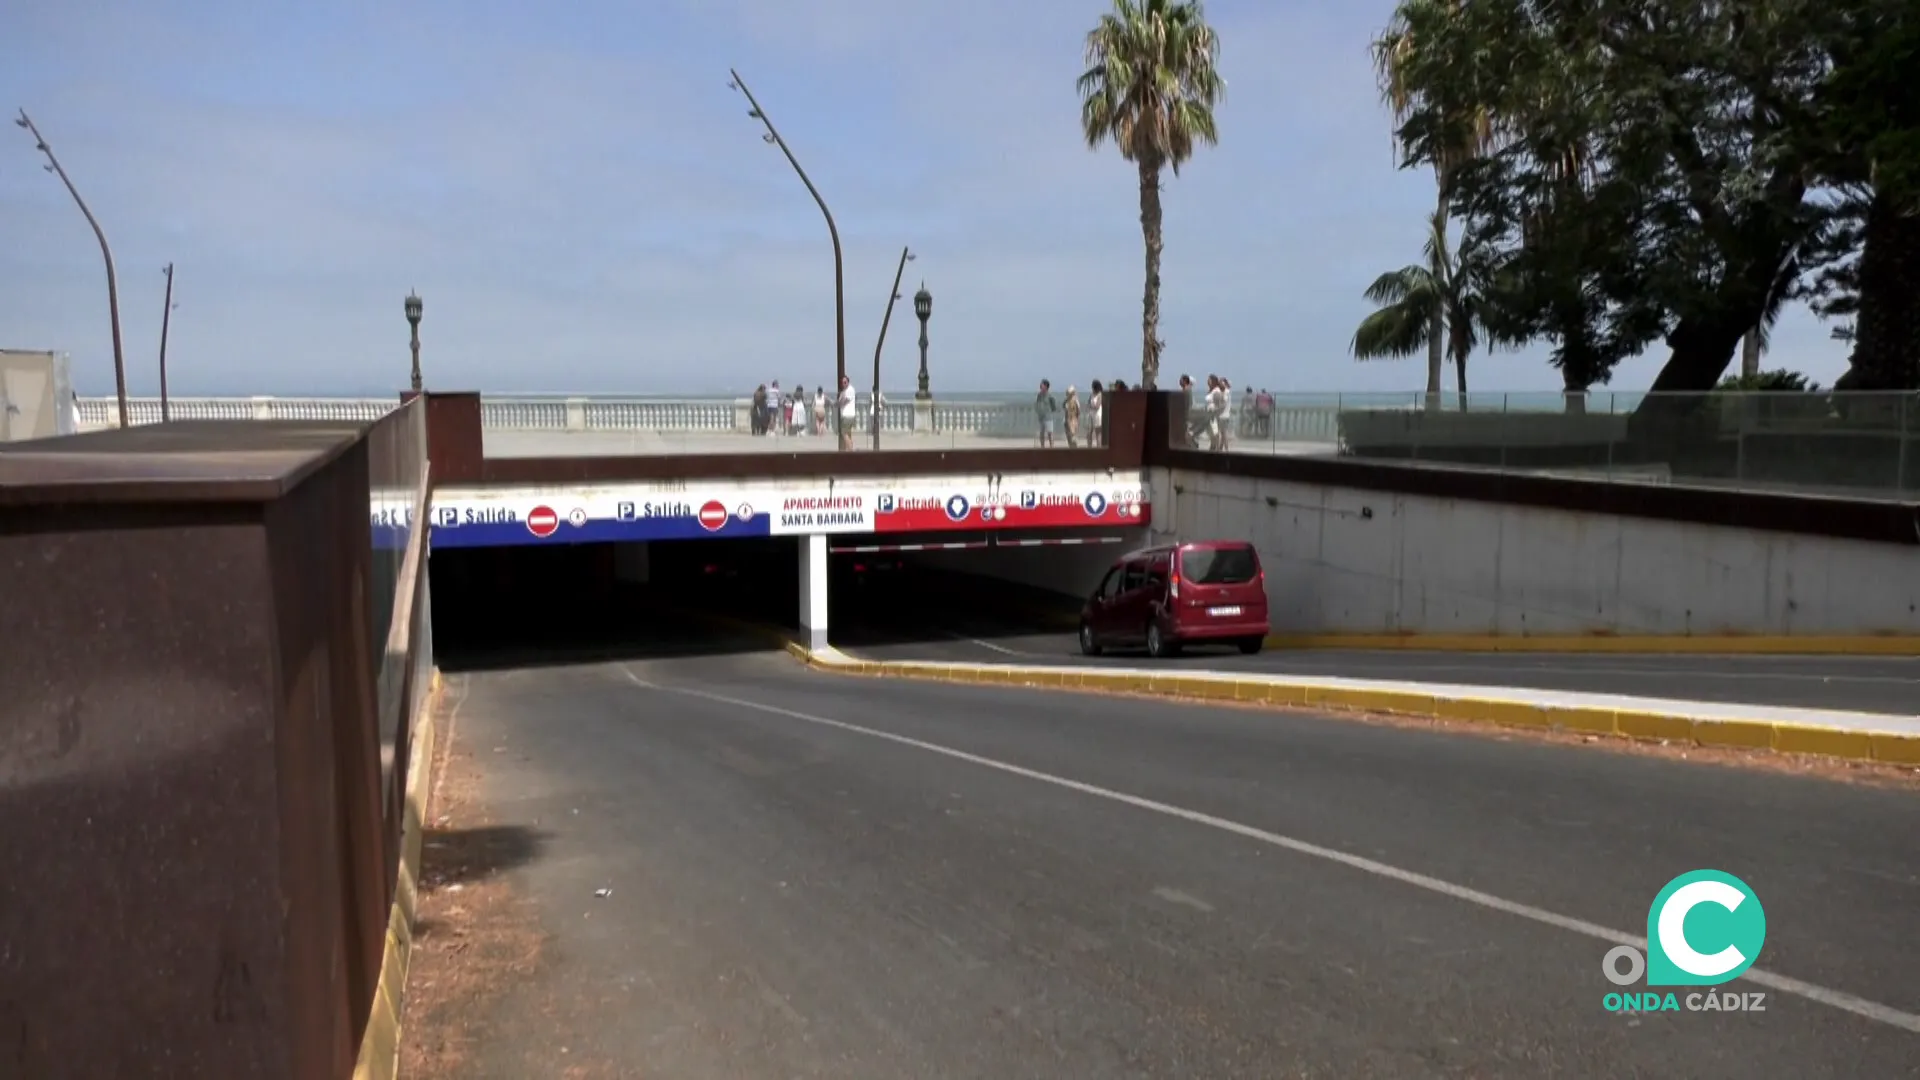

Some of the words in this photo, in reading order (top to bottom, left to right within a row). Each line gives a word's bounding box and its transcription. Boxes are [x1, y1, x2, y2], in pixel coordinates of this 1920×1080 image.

[783, 496, 863, 511] APARCAMIENTO
[898, 496, 942, 511] Entrada
[1039, 493, 1080, 507] Entrada
[466, 507, 516, 524] Salida
[644, 501, 691, 518] Salida
[781, 513, 814, 527] SANTA
[816, 512, 864, 526] BARBARA
